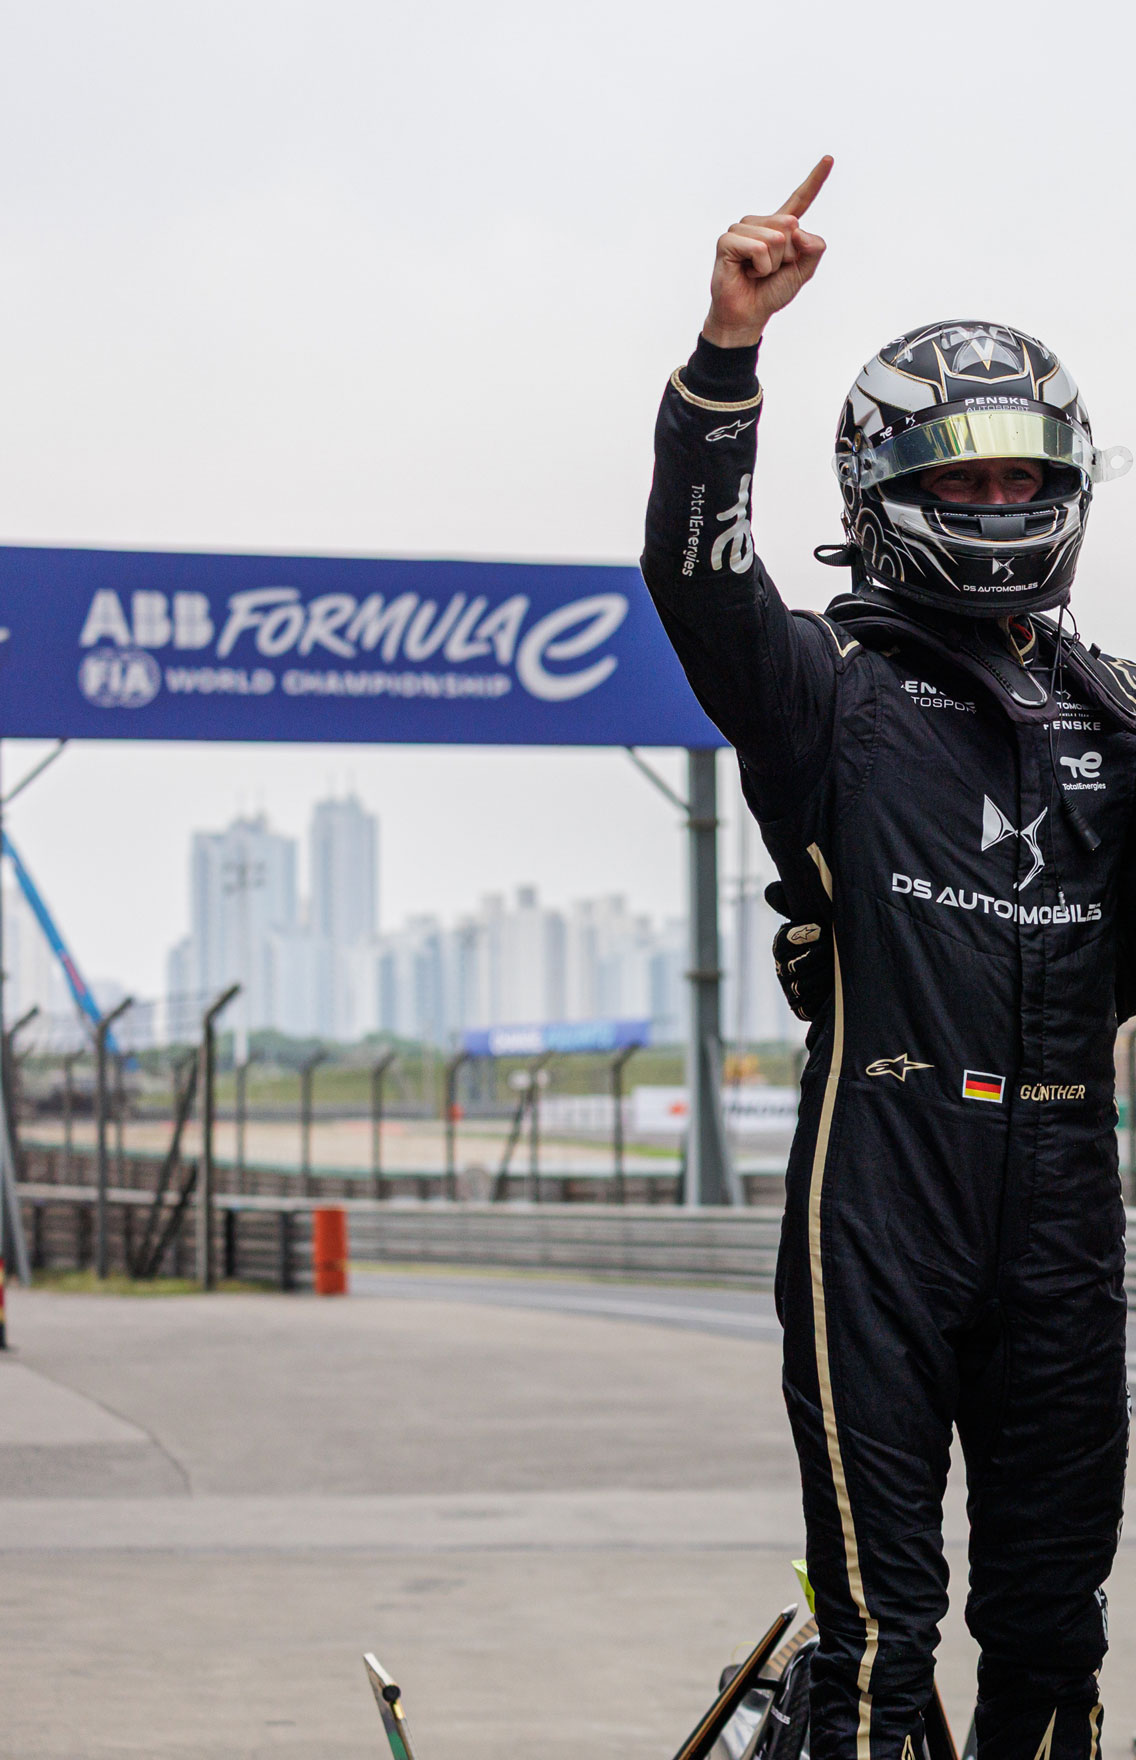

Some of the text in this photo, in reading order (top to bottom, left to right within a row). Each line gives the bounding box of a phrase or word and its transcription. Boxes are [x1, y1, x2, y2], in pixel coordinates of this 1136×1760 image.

[964, 396, 1029, 406] PENSKE
[682, 484, 705, 577] TotalEnergies
[963, 582, 1039, 593] DS AUTOMOBILES
[80, 588, 215, 647] ABB
[217, 587, 530, 664] FORMULA
[82, 655, 156, 698] FIA
[166, 667, 511, 698] WORLD CHAMPIONSHIP
[1062, 782, 1106, 791] TotalEnergies
[892, 873, 1102, 925] DS AUTOMOBILES
[1020, 1083, 1086, 1101] GÜNTHER
